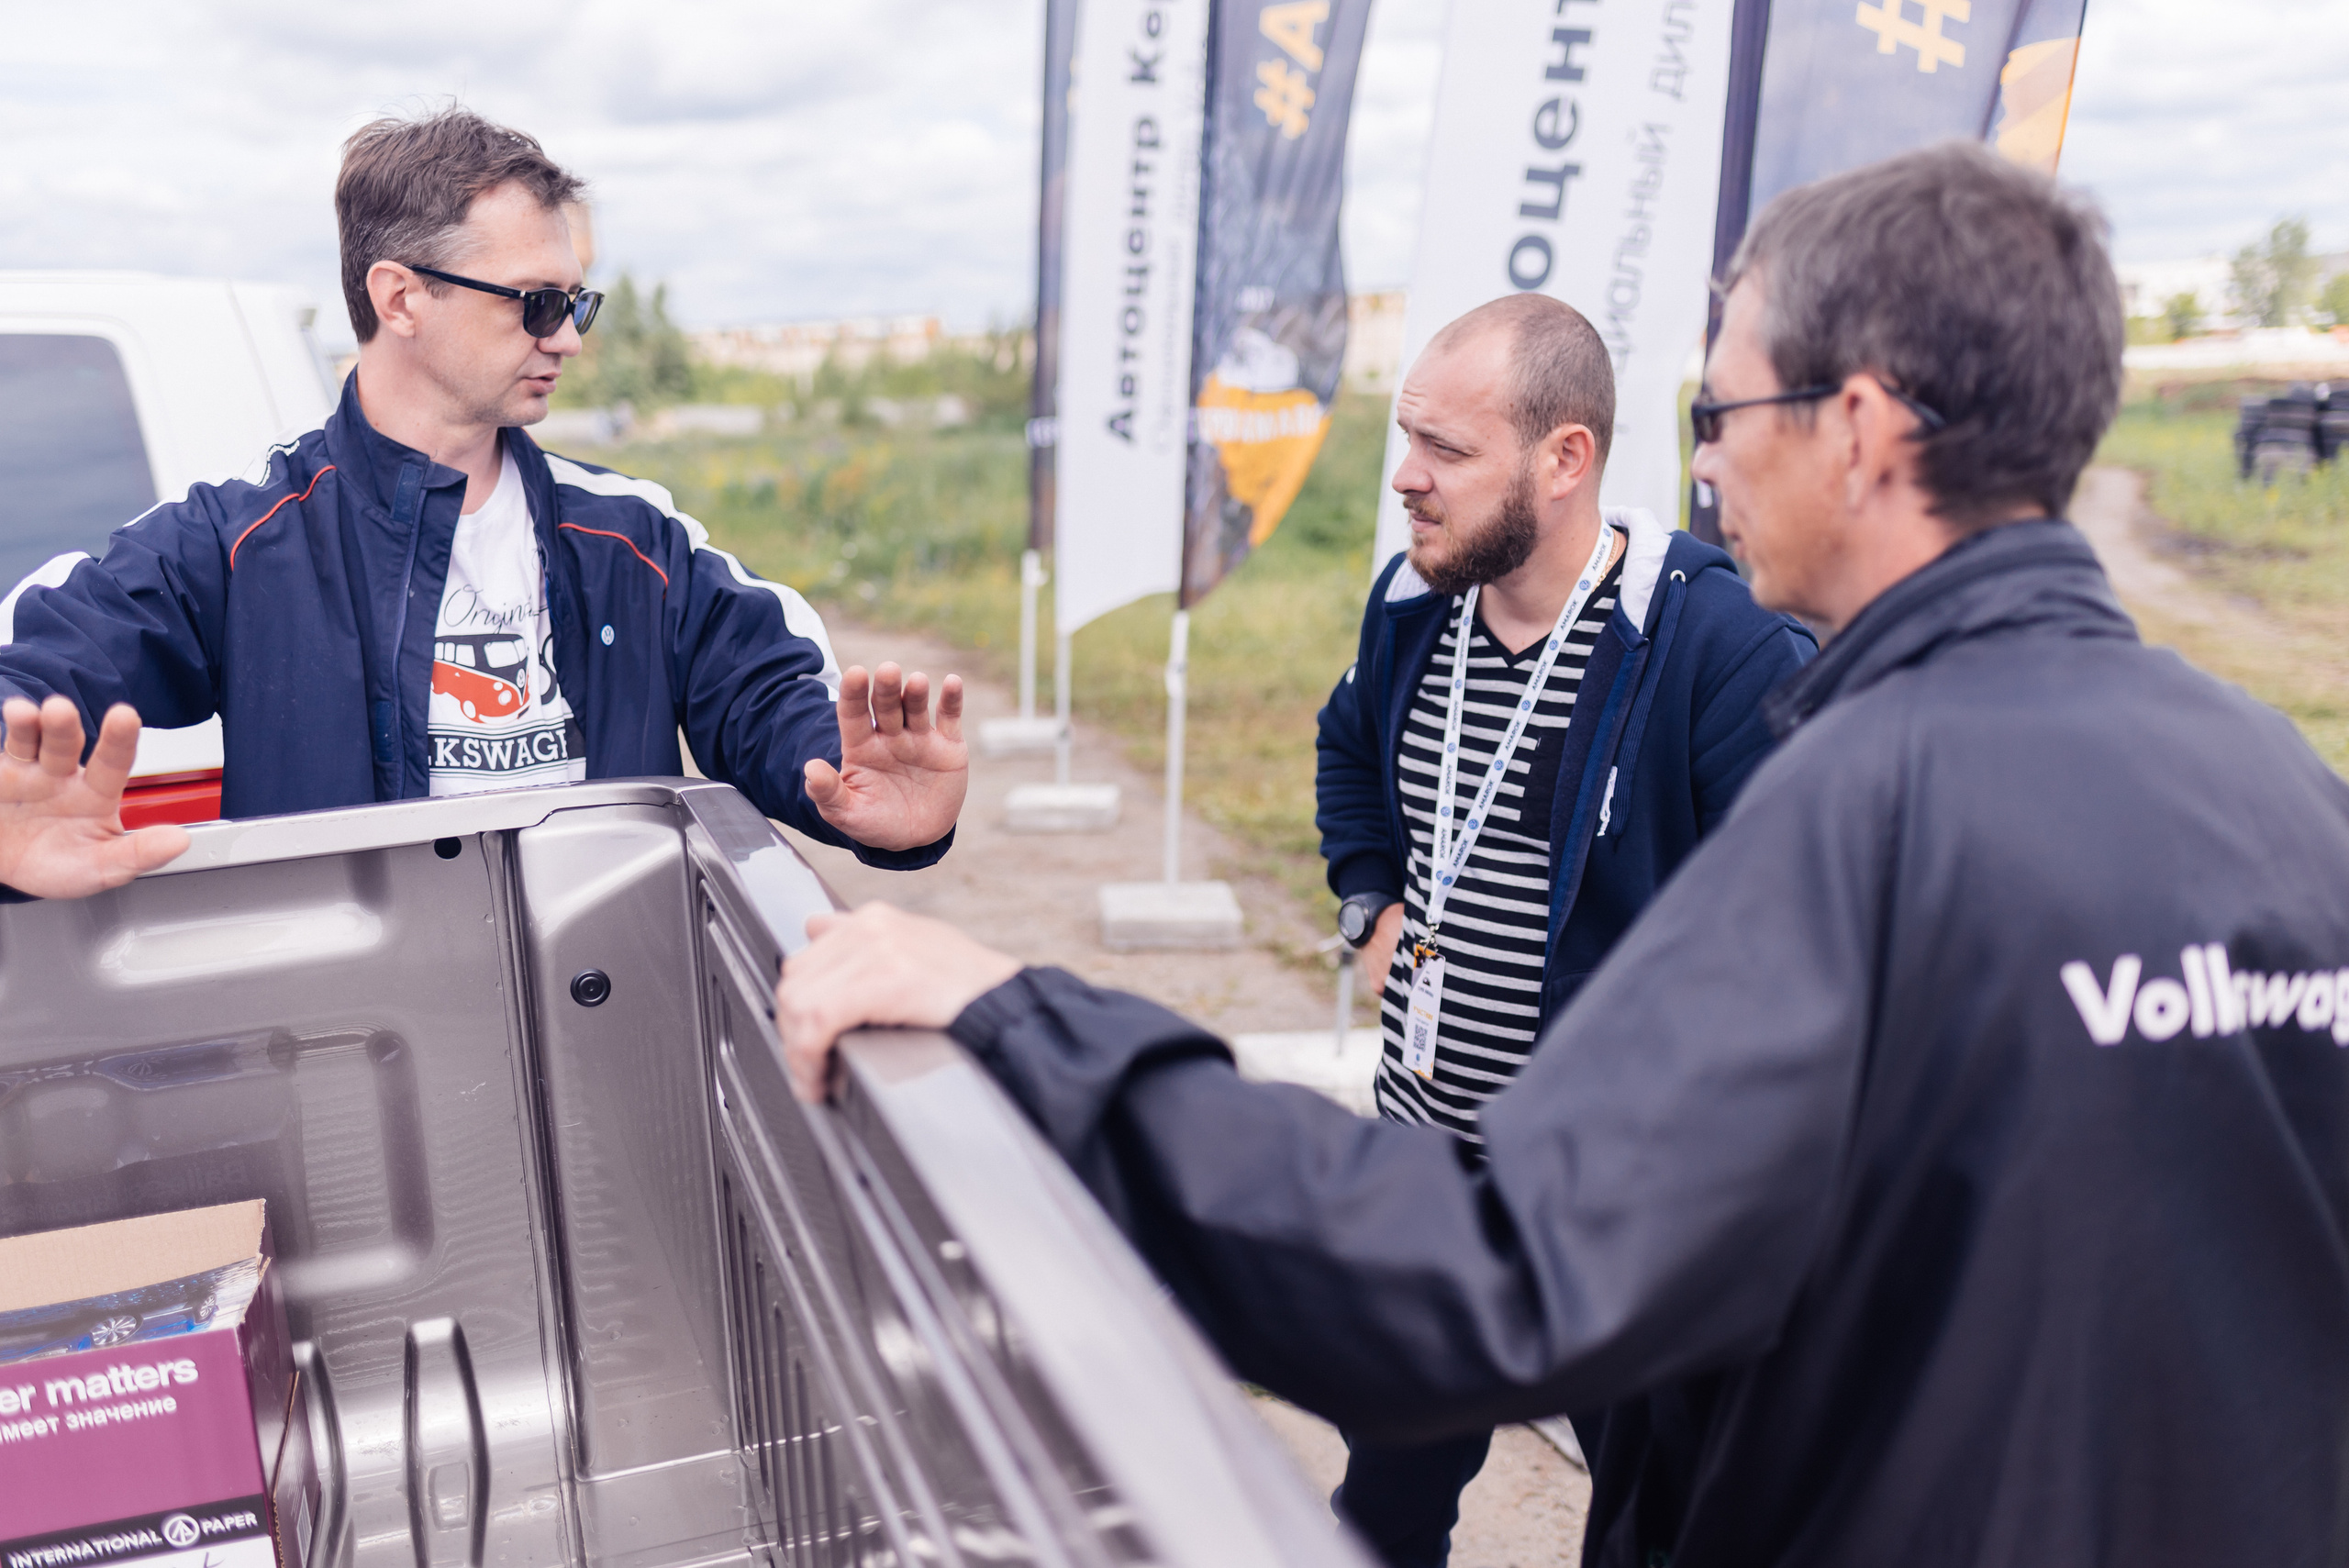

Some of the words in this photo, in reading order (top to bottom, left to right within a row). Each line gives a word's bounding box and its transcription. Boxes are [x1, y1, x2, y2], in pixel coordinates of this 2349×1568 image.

[1129, 0, 1170, 86] Ке
[1107, 117, 1163, 446] Автоцентр
[1560, 599, 1578, 630] AMAROK
[1532, 660, 1548, 691] AMAROK
[429, 728, 567, 770] KSWAG
[1505, 719, 1521, 751] AMAROK
[1479, 778, 1495, 810] AMAROK
[1453, 838, 1469, 868] AMAROK
[46, 1359, 198, 1407] matters
[0, 1415, 59, 1444] меет
[64, 1396, 177, 1432] значение
[8, 1528, 163, 1568] INTERNATIONAL
[200, 1511, 259, 1535] PAPER
